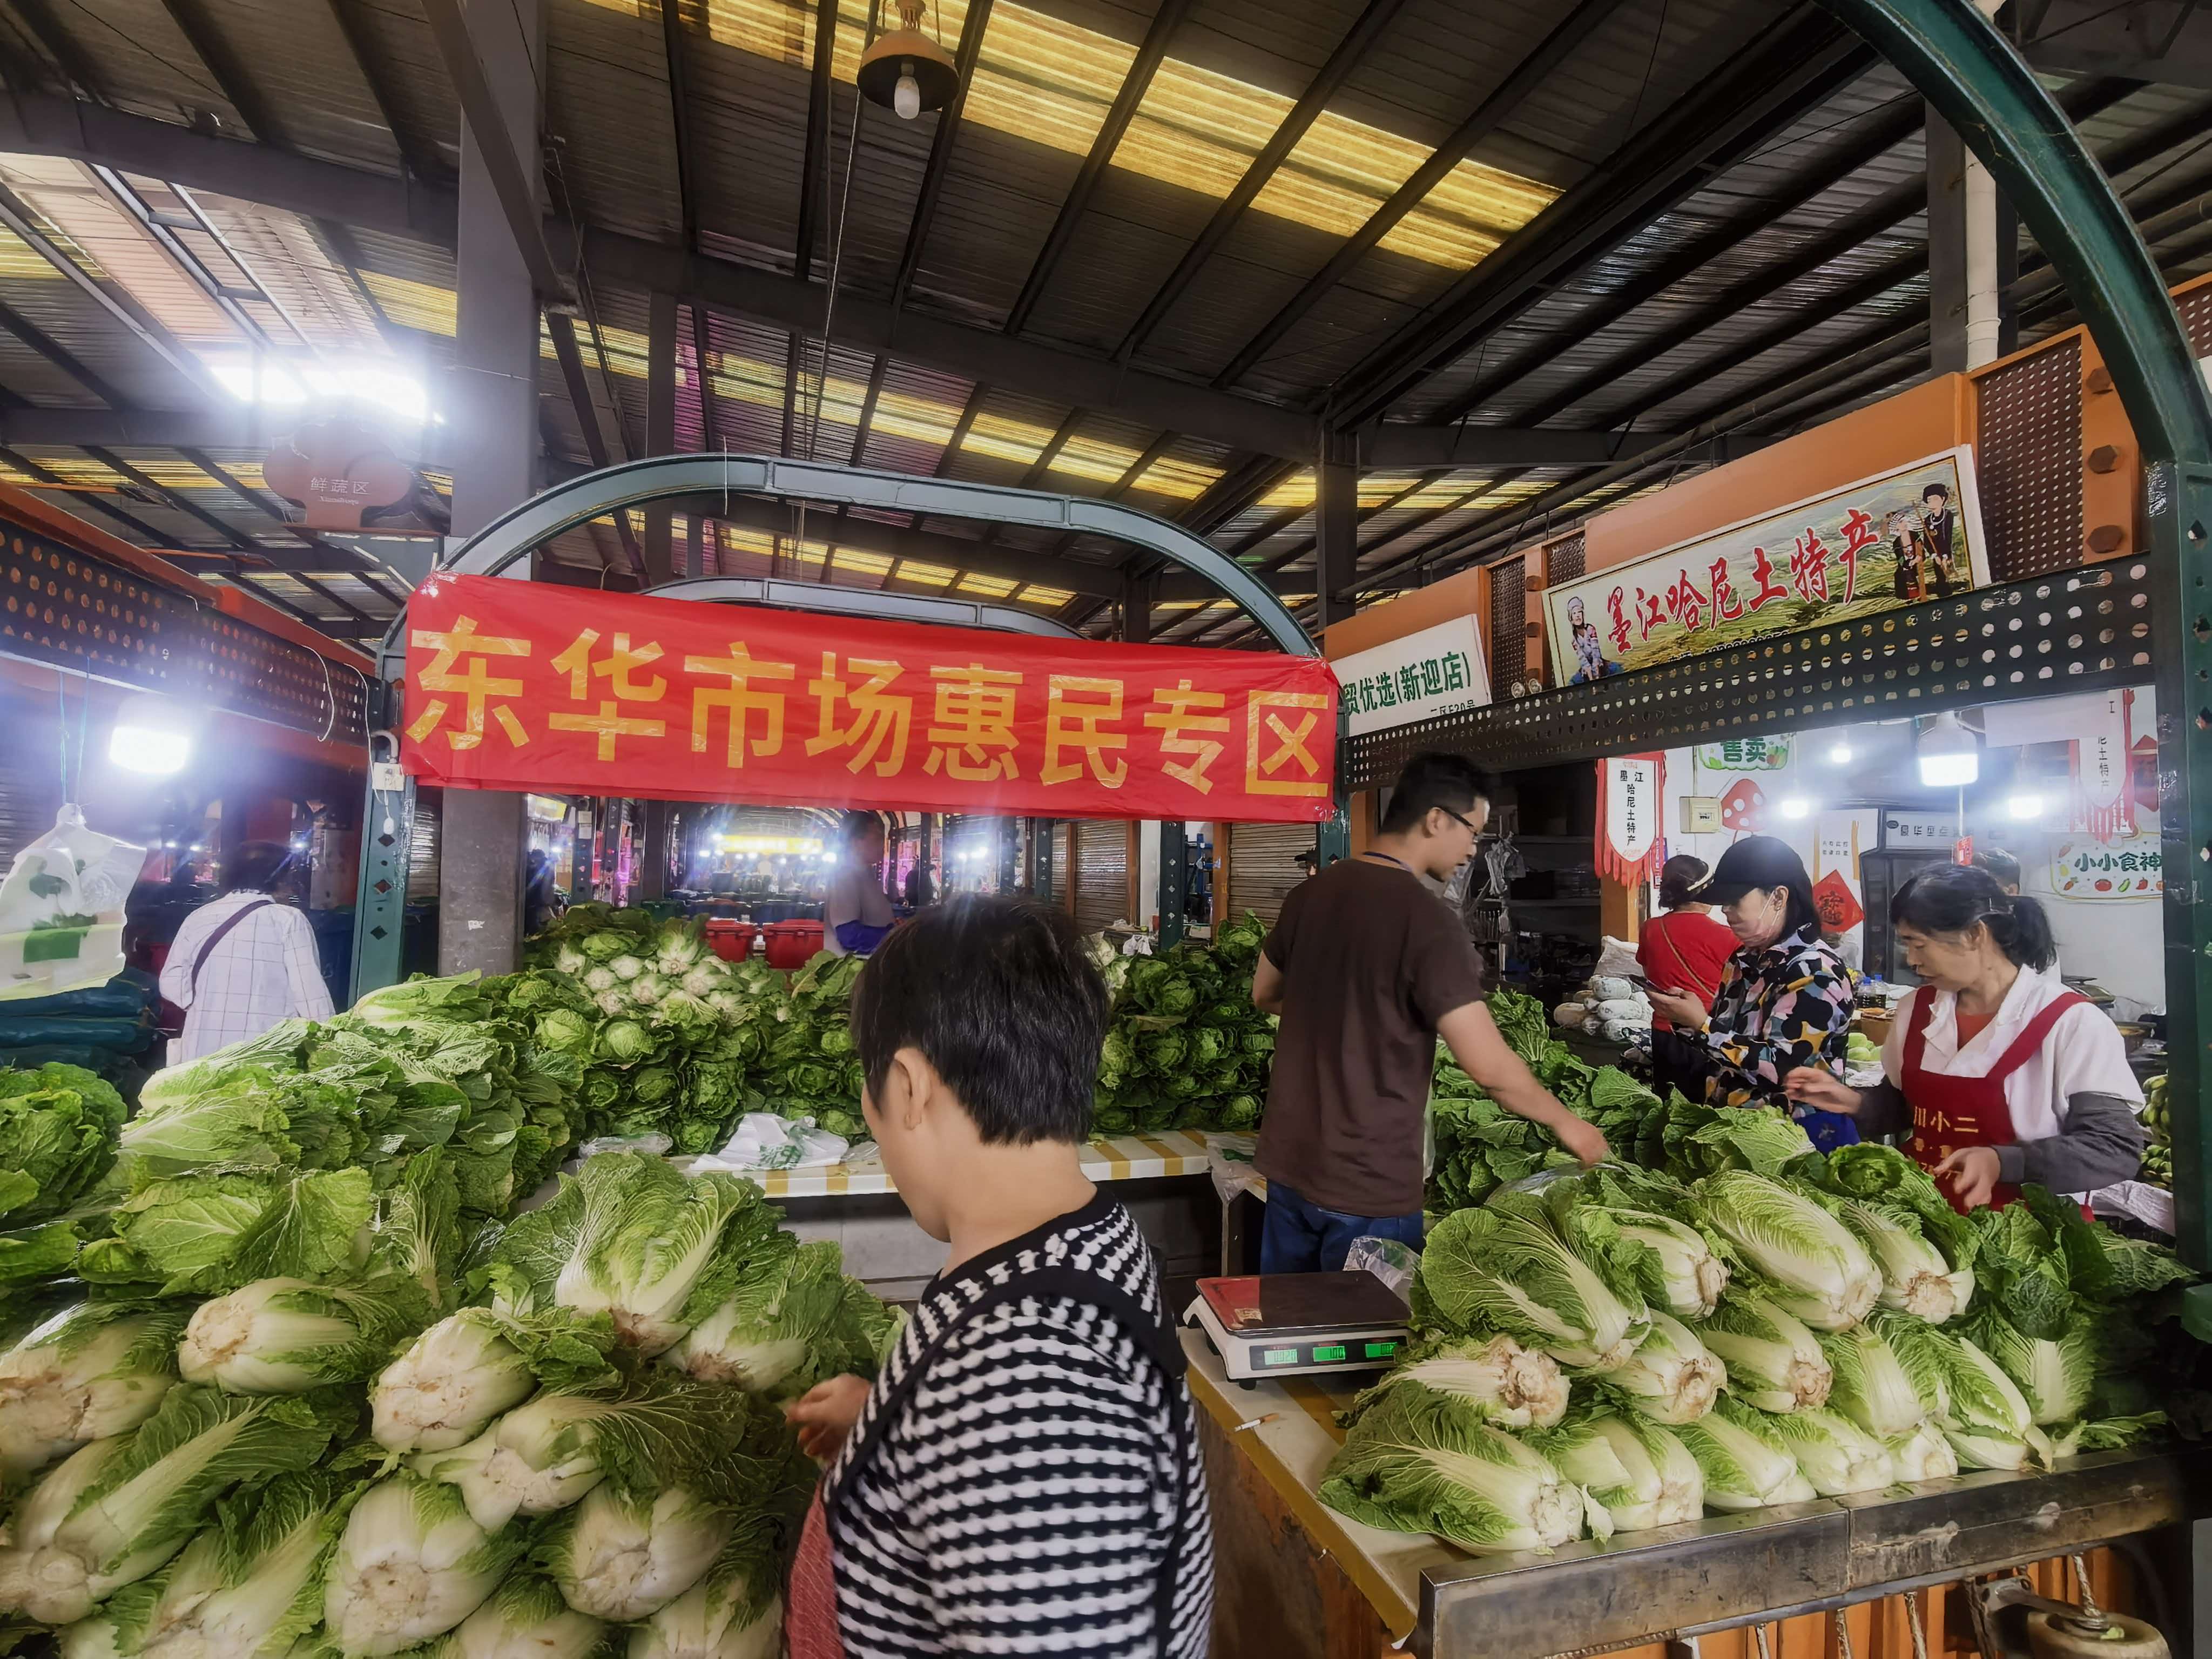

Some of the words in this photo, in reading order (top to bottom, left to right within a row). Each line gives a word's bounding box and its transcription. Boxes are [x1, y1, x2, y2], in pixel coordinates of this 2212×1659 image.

[1607, 507, 1879, 653] 墨江哈尼土特产
[405, 614, 1328, 797] 东华市场惠民专区
[2074, 852, 2161, 872] 小小食神
[1913, 1106, 1979, 1132] 川小二
